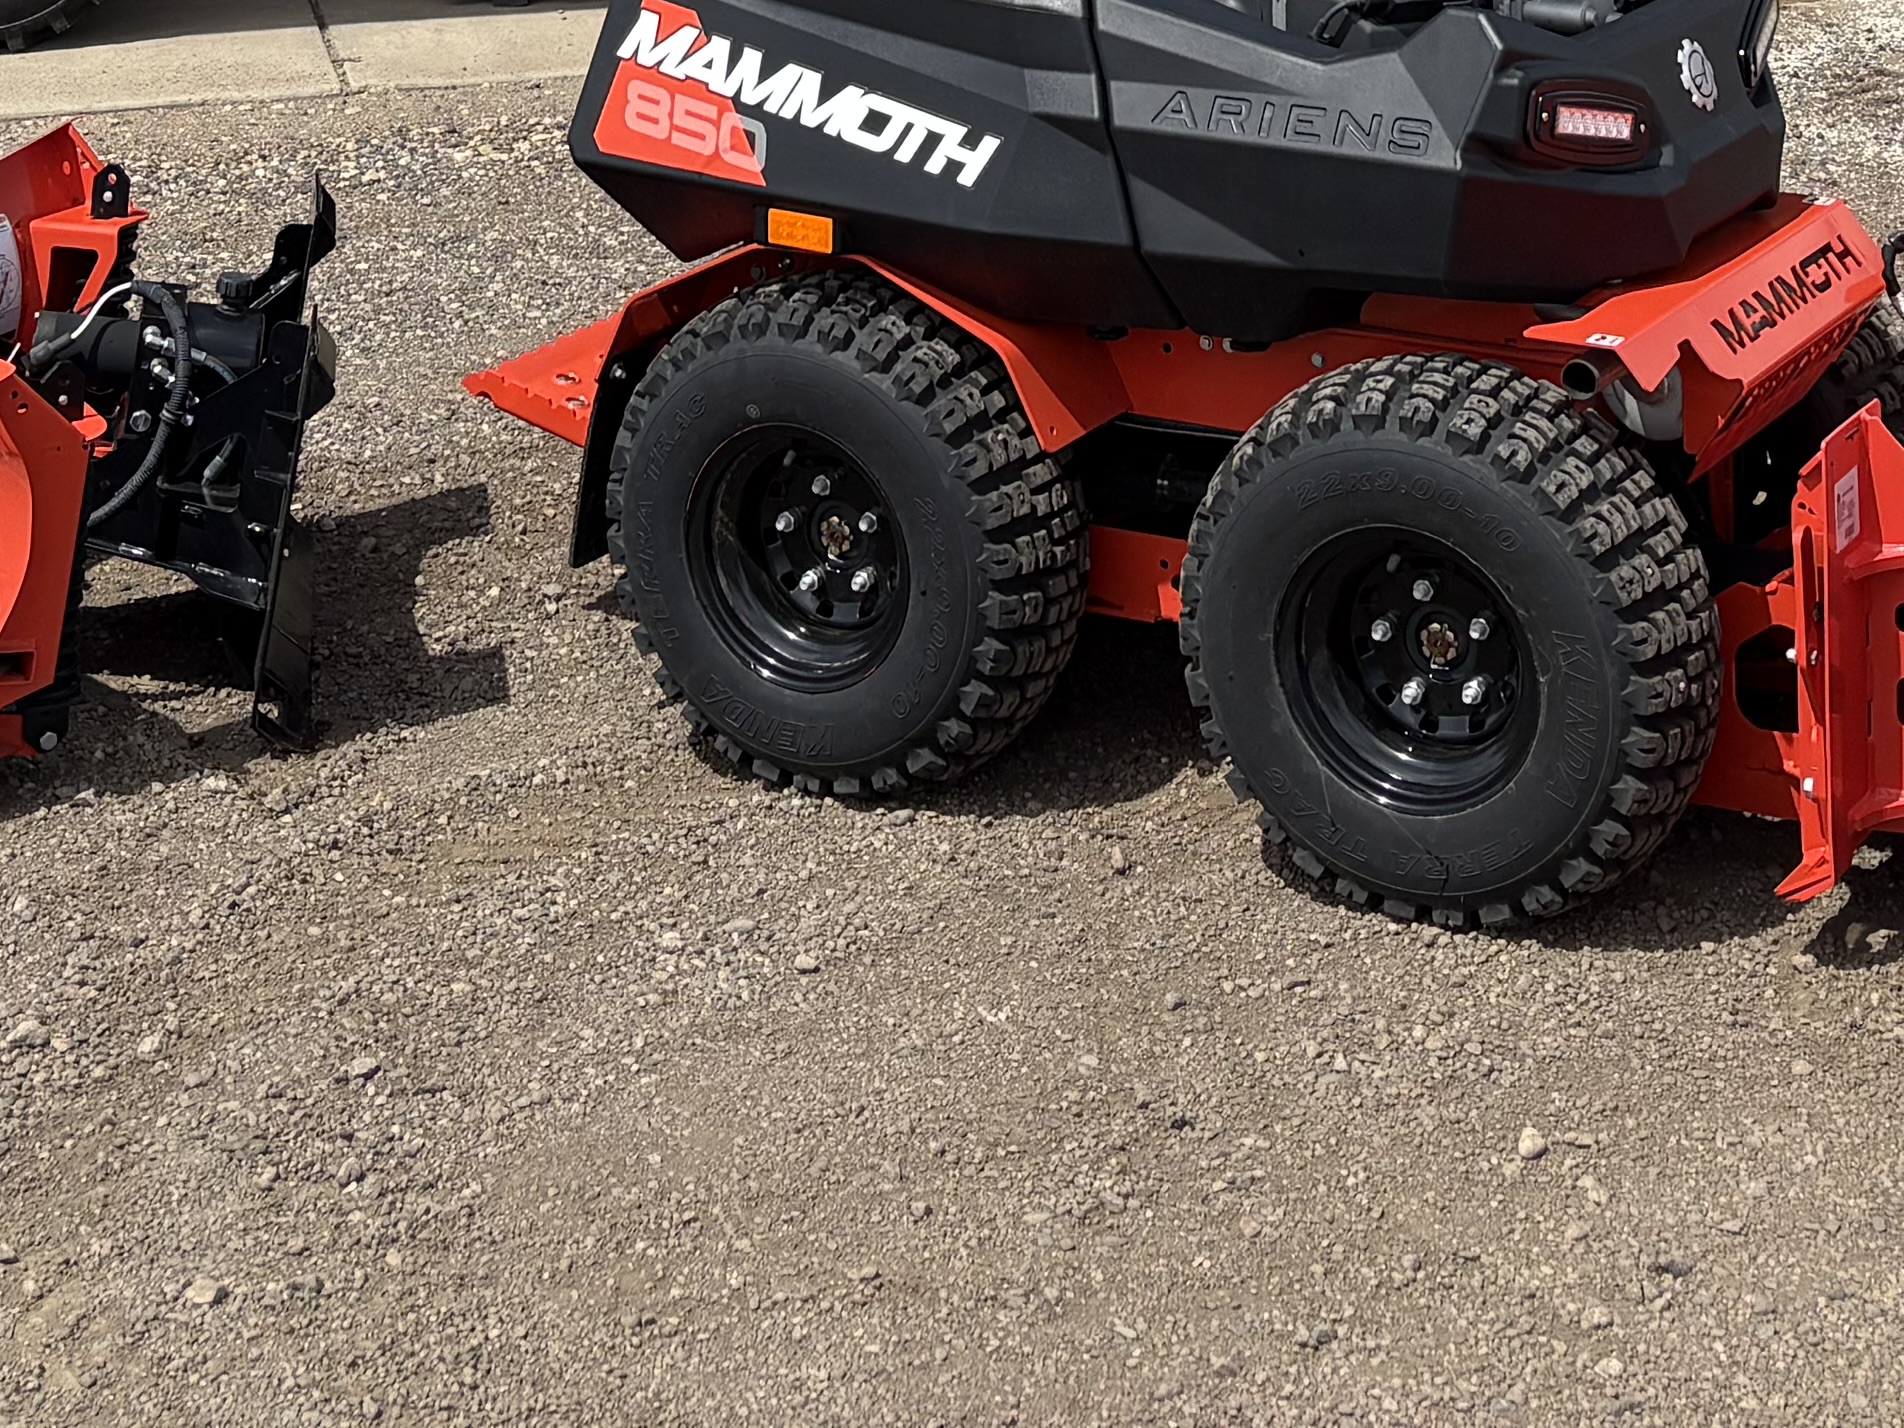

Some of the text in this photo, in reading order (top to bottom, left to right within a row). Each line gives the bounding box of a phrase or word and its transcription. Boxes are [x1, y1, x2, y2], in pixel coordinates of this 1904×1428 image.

[616, 9, 1003, 189] MAMMOTH
[624, 80, 767, 173] 850
[1151, 90, 1433, 157] ARIENS
[1709, 233, 1862, 356] MAMMOTH
[699, 673, 838, 758] KENDA
[1546, 630, 1603, 809] KENDA
